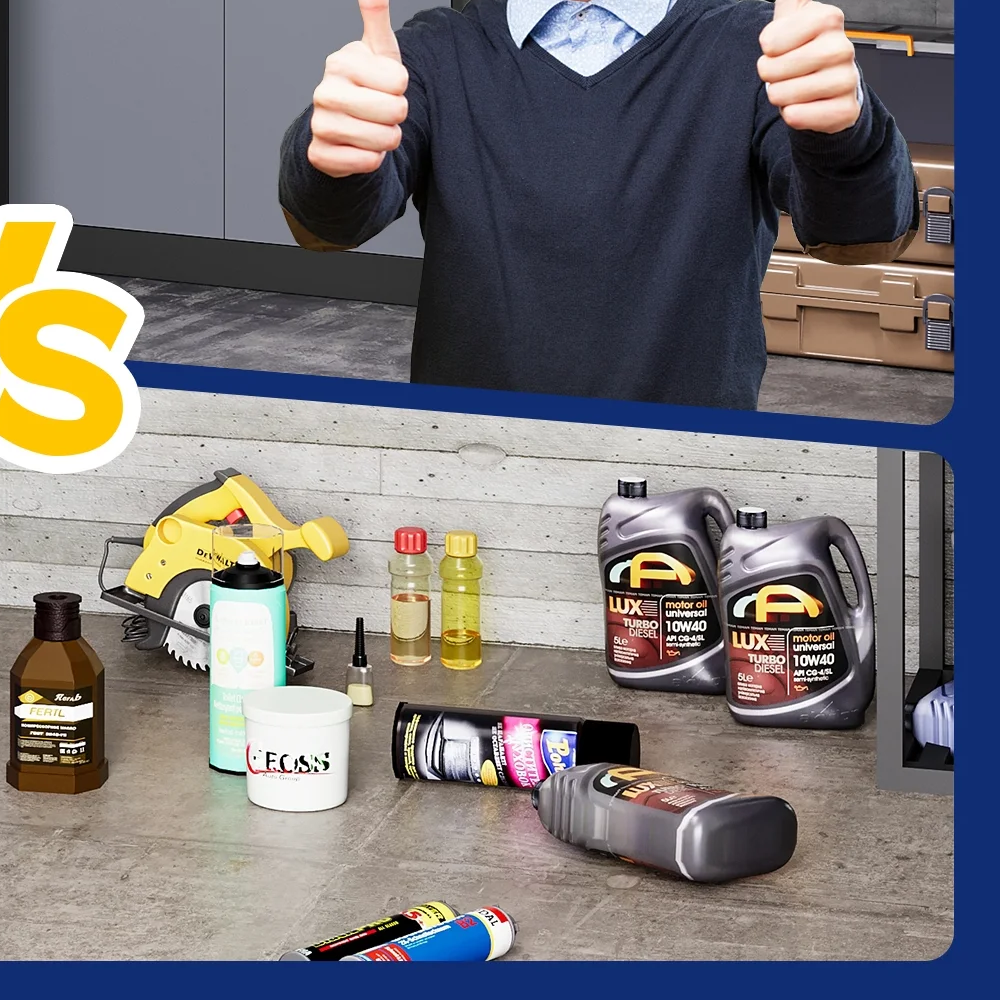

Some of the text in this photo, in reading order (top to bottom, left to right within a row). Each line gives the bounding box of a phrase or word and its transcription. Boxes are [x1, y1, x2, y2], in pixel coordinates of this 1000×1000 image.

[609, 596, 644, 616] LUX
[666, 600, 707, 609] motor oil
[666, 609, 707, 618] universal
[623, 618, 658, 629] TURBO
[666, 621, 707, 632] 10W40
[629, 629, 658, 638] DIESEL
[793, 632, 835, 642] motor oil
[732, 631, 770, 651] LUX
[793, 641, 835, 651] universal
[748, 654, 786, 665] TURBO
[793, 653, 835, 666] 10W40
[754, 664, 785, 674] DIESEL
